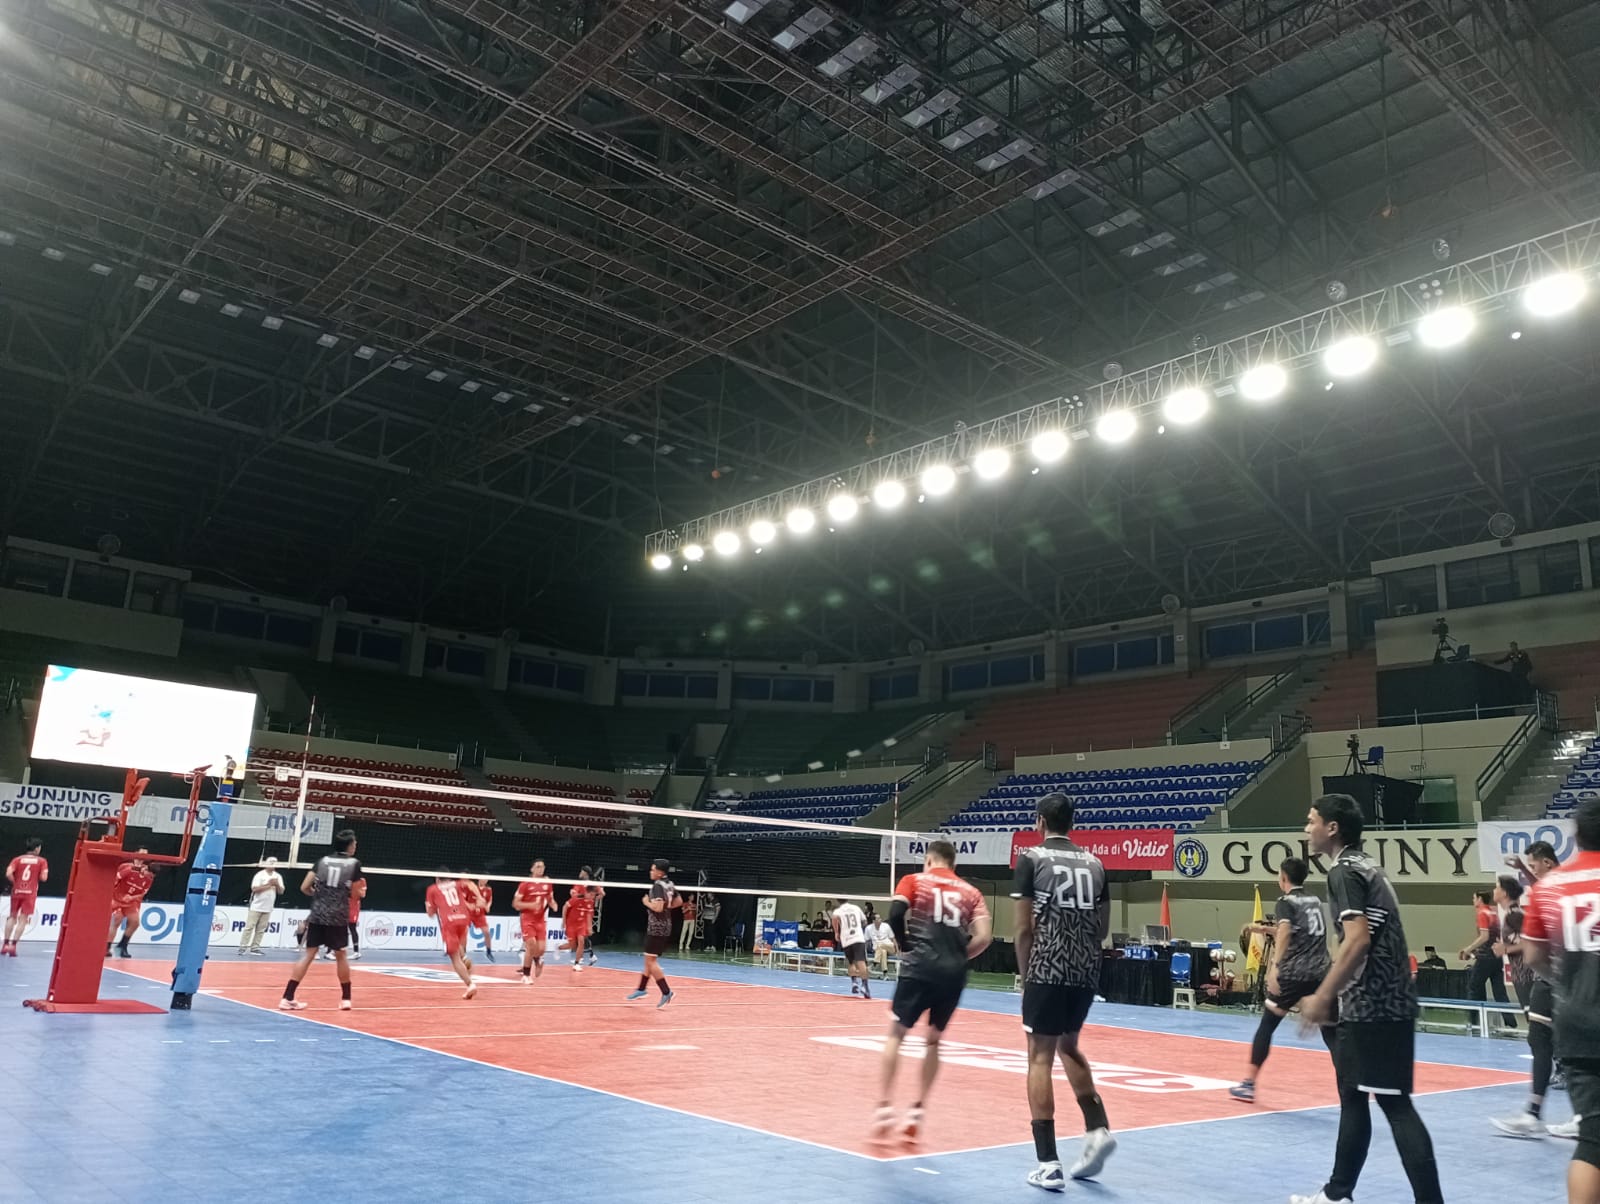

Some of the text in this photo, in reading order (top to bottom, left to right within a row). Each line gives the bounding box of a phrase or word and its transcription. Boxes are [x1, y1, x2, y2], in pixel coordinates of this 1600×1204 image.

[17, 786, 112, 806] JUNJUNG
[1092, 843, 1109, 856] Ada
[1111, 843, 1121, 856] di
[1123, 838, 1169, 859] Vidio
[22, 864, 32, 881] 6
[1052, 864, 1096, 910] 20
[932, 887, 963, 928] 15
[845, 913, 858, 929] 13
[1558, 893, 1600, 952] 12
[409, 926, 438, 937] PBVSI
